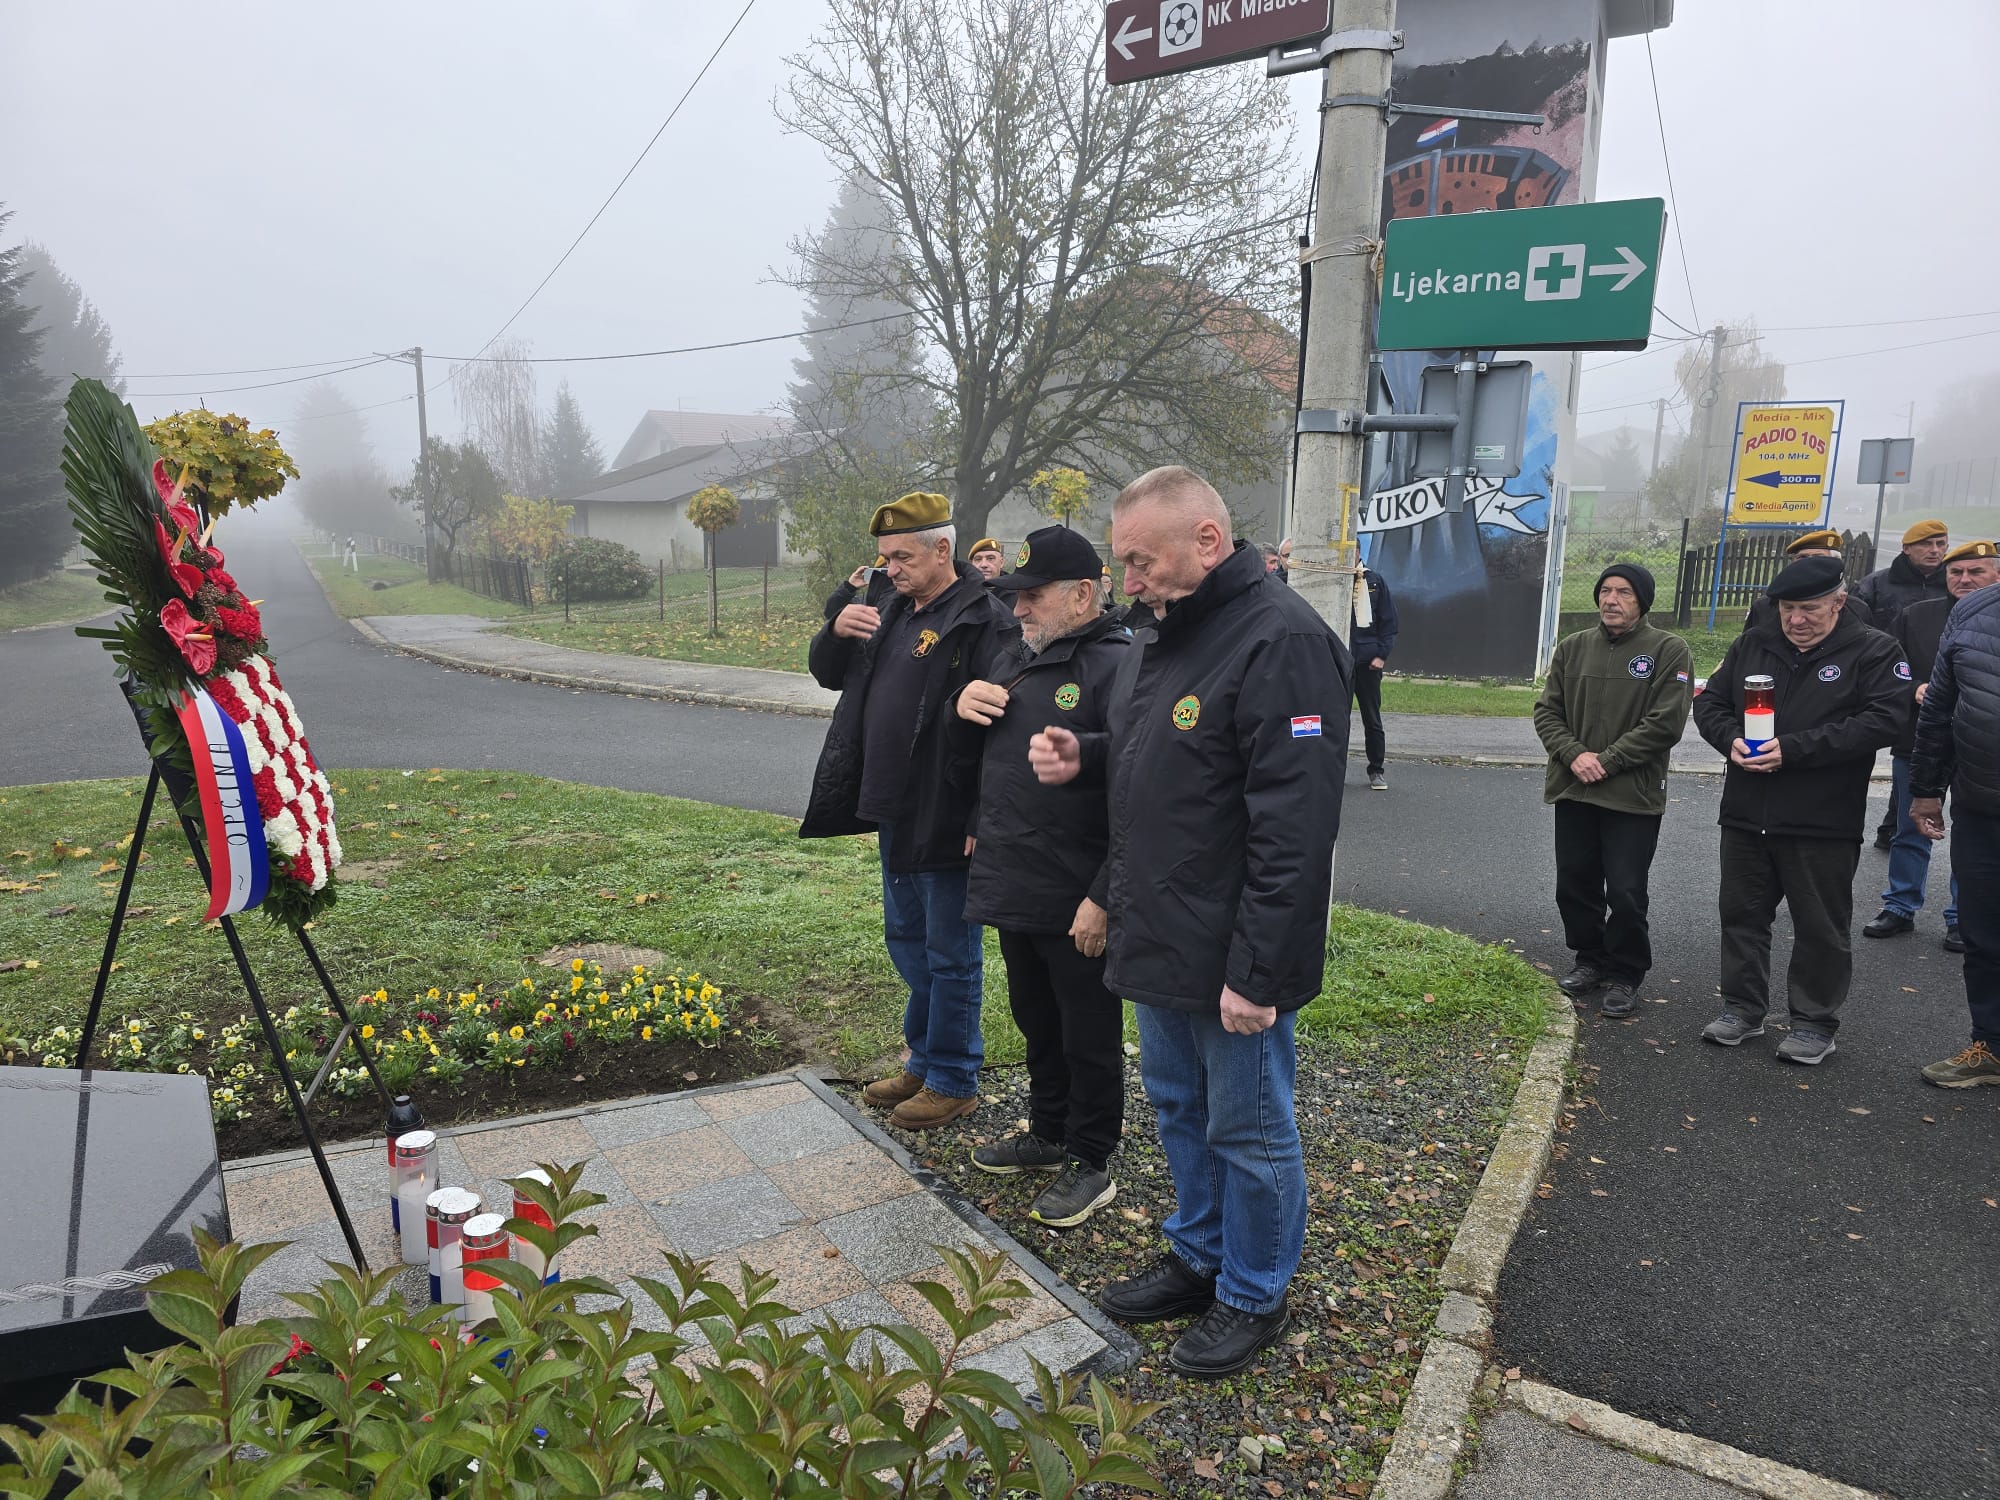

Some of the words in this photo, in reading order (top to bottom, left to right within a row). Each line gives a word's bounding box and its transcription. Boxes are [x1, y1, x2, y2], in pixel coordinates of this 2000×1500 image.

[1207, 0, 1232, 27] NK
[1392, 268, 1520, 302] Ljekarna
[1752, 413, 1790, 422] Media
[1802, 411, 1825, 421] Mix
[1744, 427, 1797, 455] RADIO
[1801, 431, 1826, 455] 105
